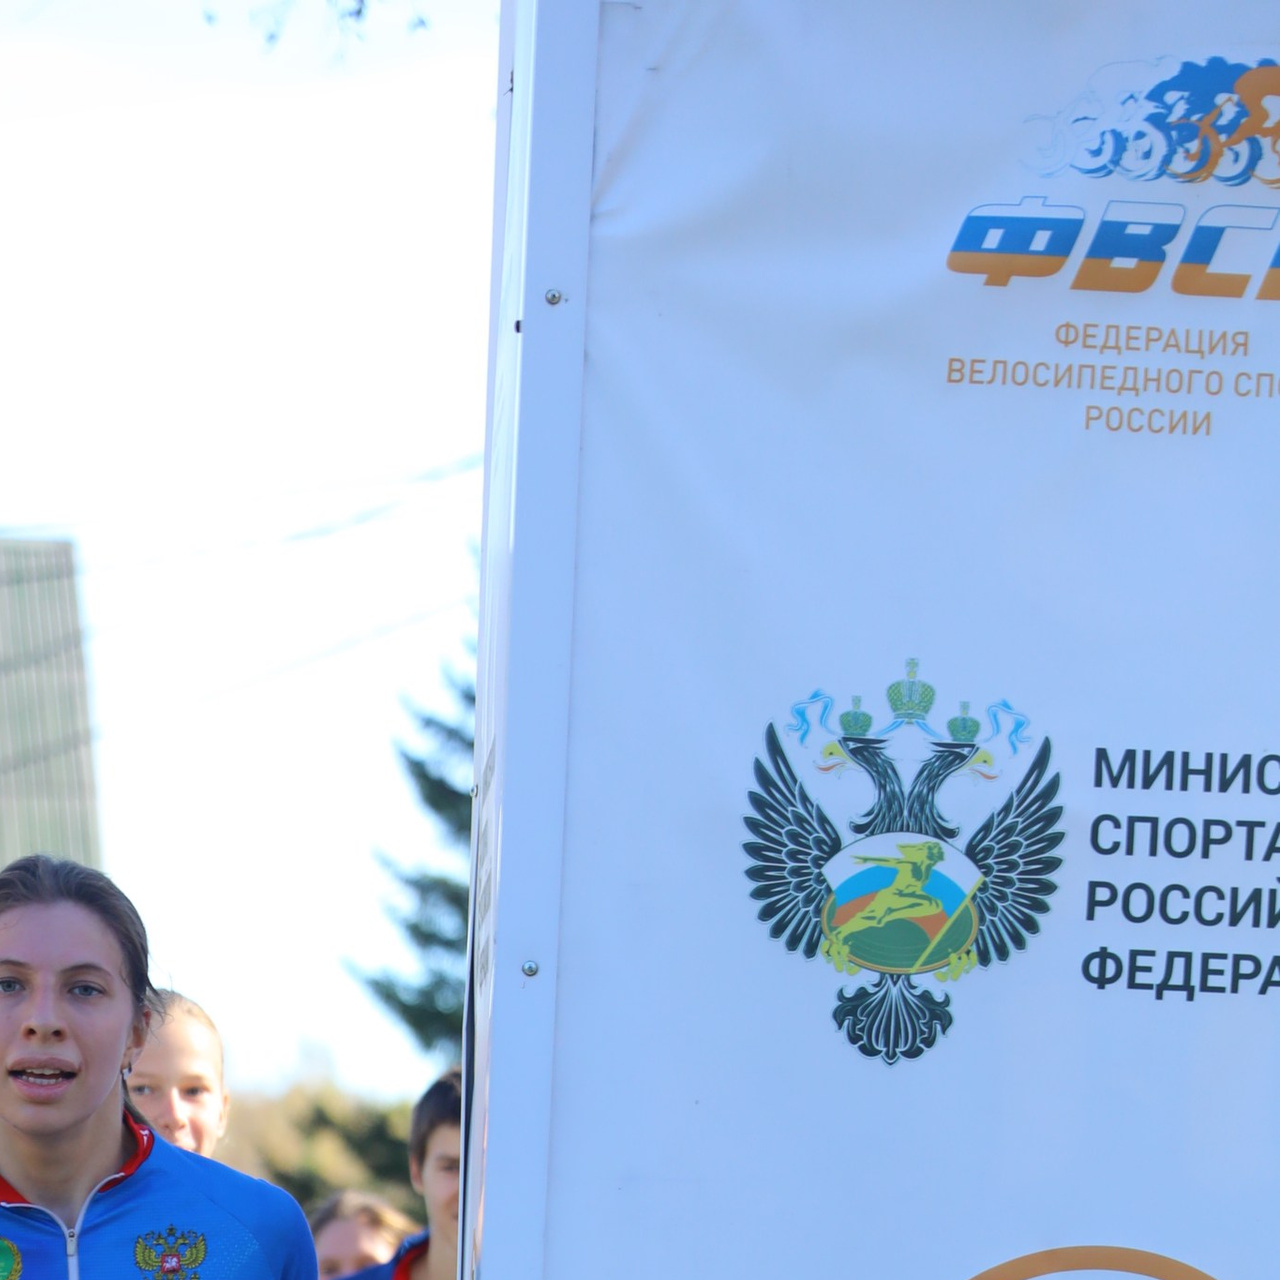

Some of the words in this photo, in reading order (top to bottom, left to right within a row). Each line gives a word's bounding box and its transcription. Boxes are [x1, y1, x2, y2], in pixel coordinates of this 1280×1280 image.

[946, 196, 1280, 300] ФВС
[1055, 321, 1250, 359] ФЕДЕРАЦИЯ
[946, 357, 1224, 397] ВЕЛОСИПЕДНОГО
[1233, 371, 1280, 398] СП
[1084, 405, 1212, 436] РОССИИ
